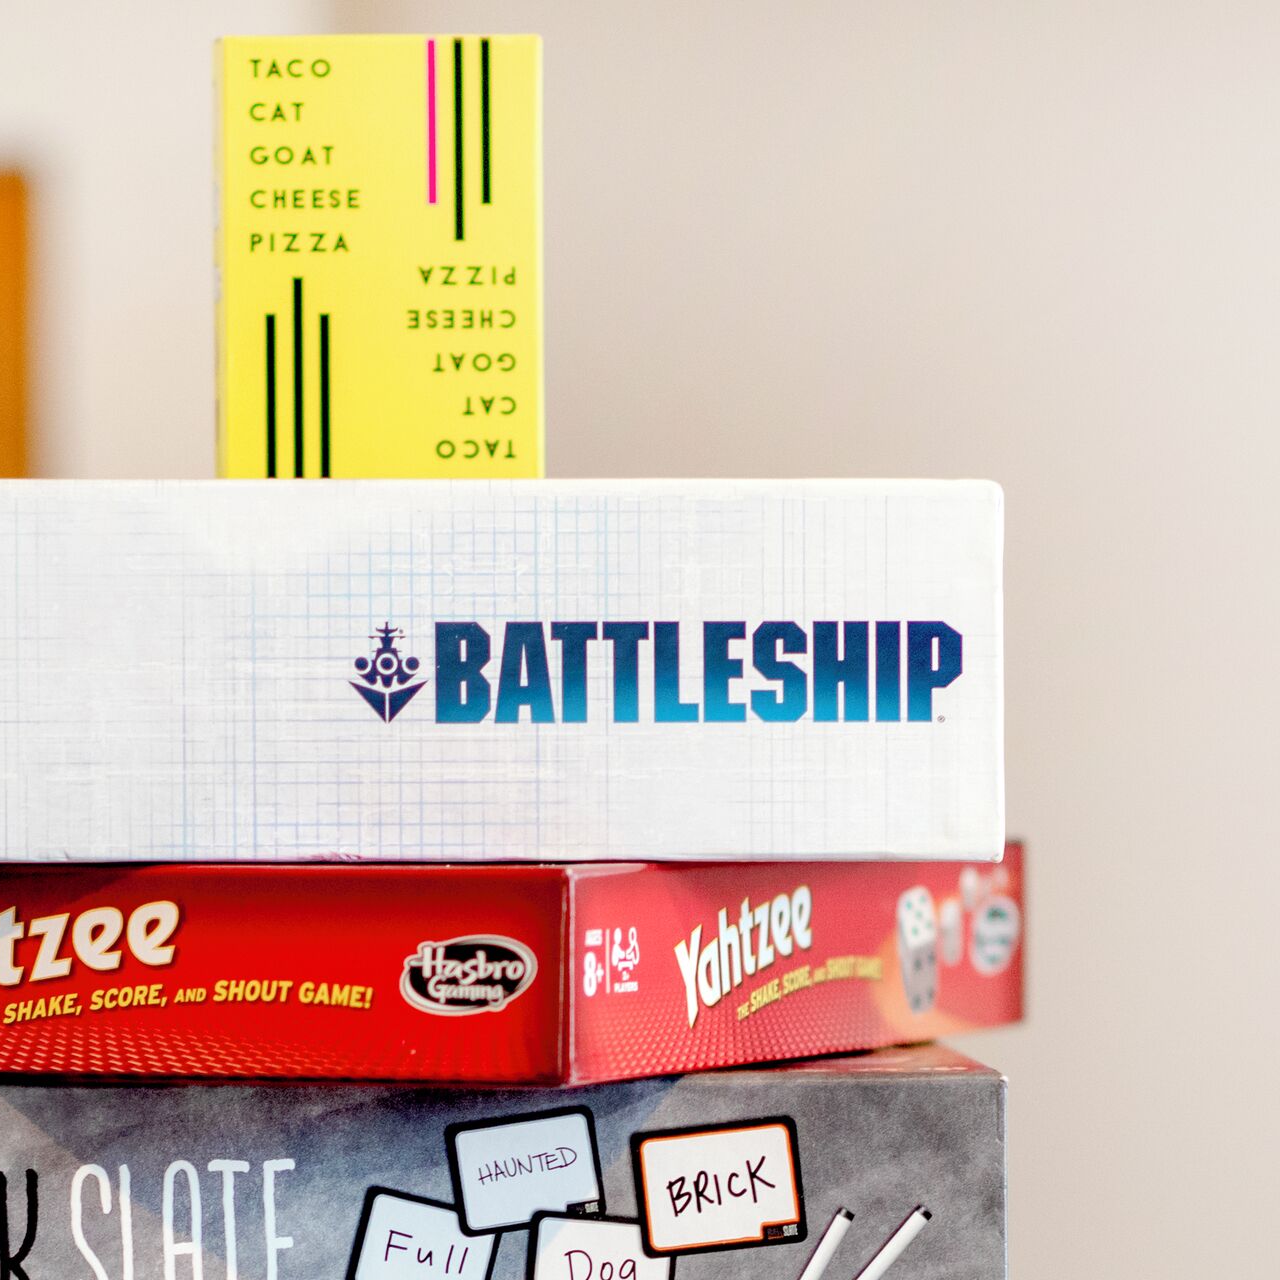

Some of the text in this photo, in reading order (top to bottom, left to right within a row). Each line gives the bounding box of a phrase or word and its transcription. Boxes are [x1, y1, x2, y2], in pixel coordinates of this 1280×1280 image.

[249, 59, 331, 78] TACO
[249, 103, 304, 122] CAT
[249, 147, 334, 165] GOAT
[249, 190, 361, 209] CHEESE
[249, 233, 350, 252] PIZZA
[419, 266, 516, 286] PIZZA
[407, 310, 517, 329] CHEESE
[433, 353, 517, 372] GOAT
[463, 397, 517, 415] CAT
[436, 439, 516, 458] TACO
[434, 621, 963, 723] BATTLESHIP
[410, 946, 524, 985] Hasbro
[674, 885, 812, 1028] Yahtzee
[583, 952, 604, 996] 8+
[427, 976, 504, 1005] Gaming
[3, 994, 83, 1025] SHAKE,
[90, 984, 167, 1011] SCORE,
[175, 986, 206, 1003] AND
[214, 980, 293, 1002] SHOUT
[299, 982, 374, 1009] GAME!
[478, 1146, 578, 1185] HAUNTED
[667, 1156, 776, 1217] BRICK
[383, 1230, 469, 1276] Full
